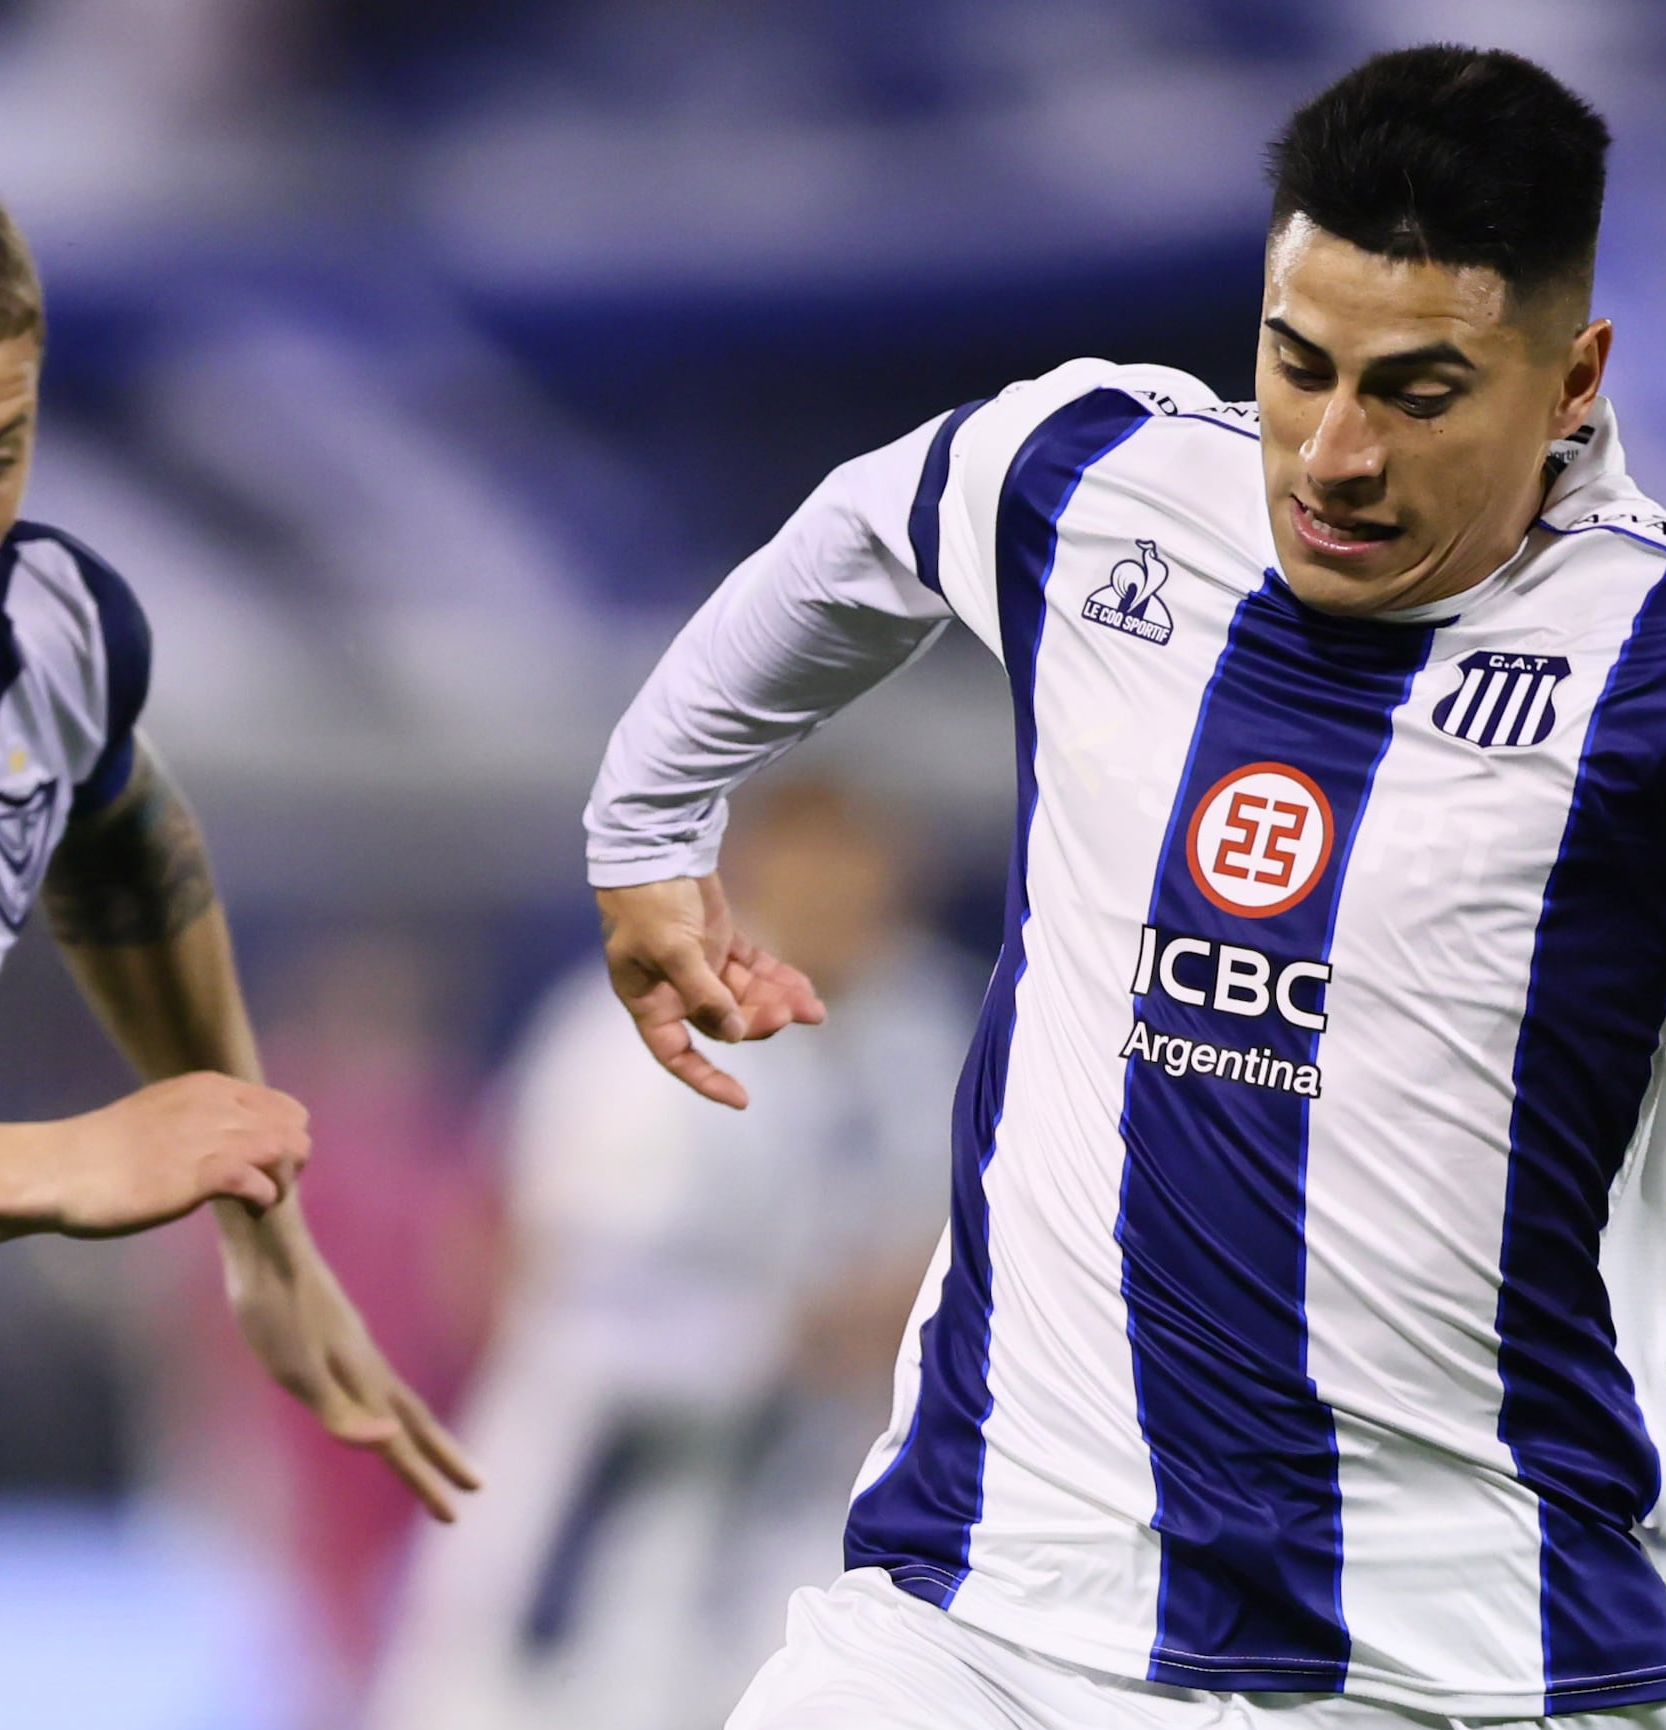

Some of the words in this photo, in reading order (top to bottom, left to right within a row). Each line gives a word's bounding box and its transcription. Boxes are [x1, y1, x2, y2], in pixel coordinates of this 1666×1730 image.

[1083, 601, 1101, 619] LE
[1099, 607, 1123, 628] COQ
[1122, 615, 1170, 643] SPORTIF
[1132, 926, 1331, 1031] ICBC
[1123, 1020, 1322, 1097] Argentina
